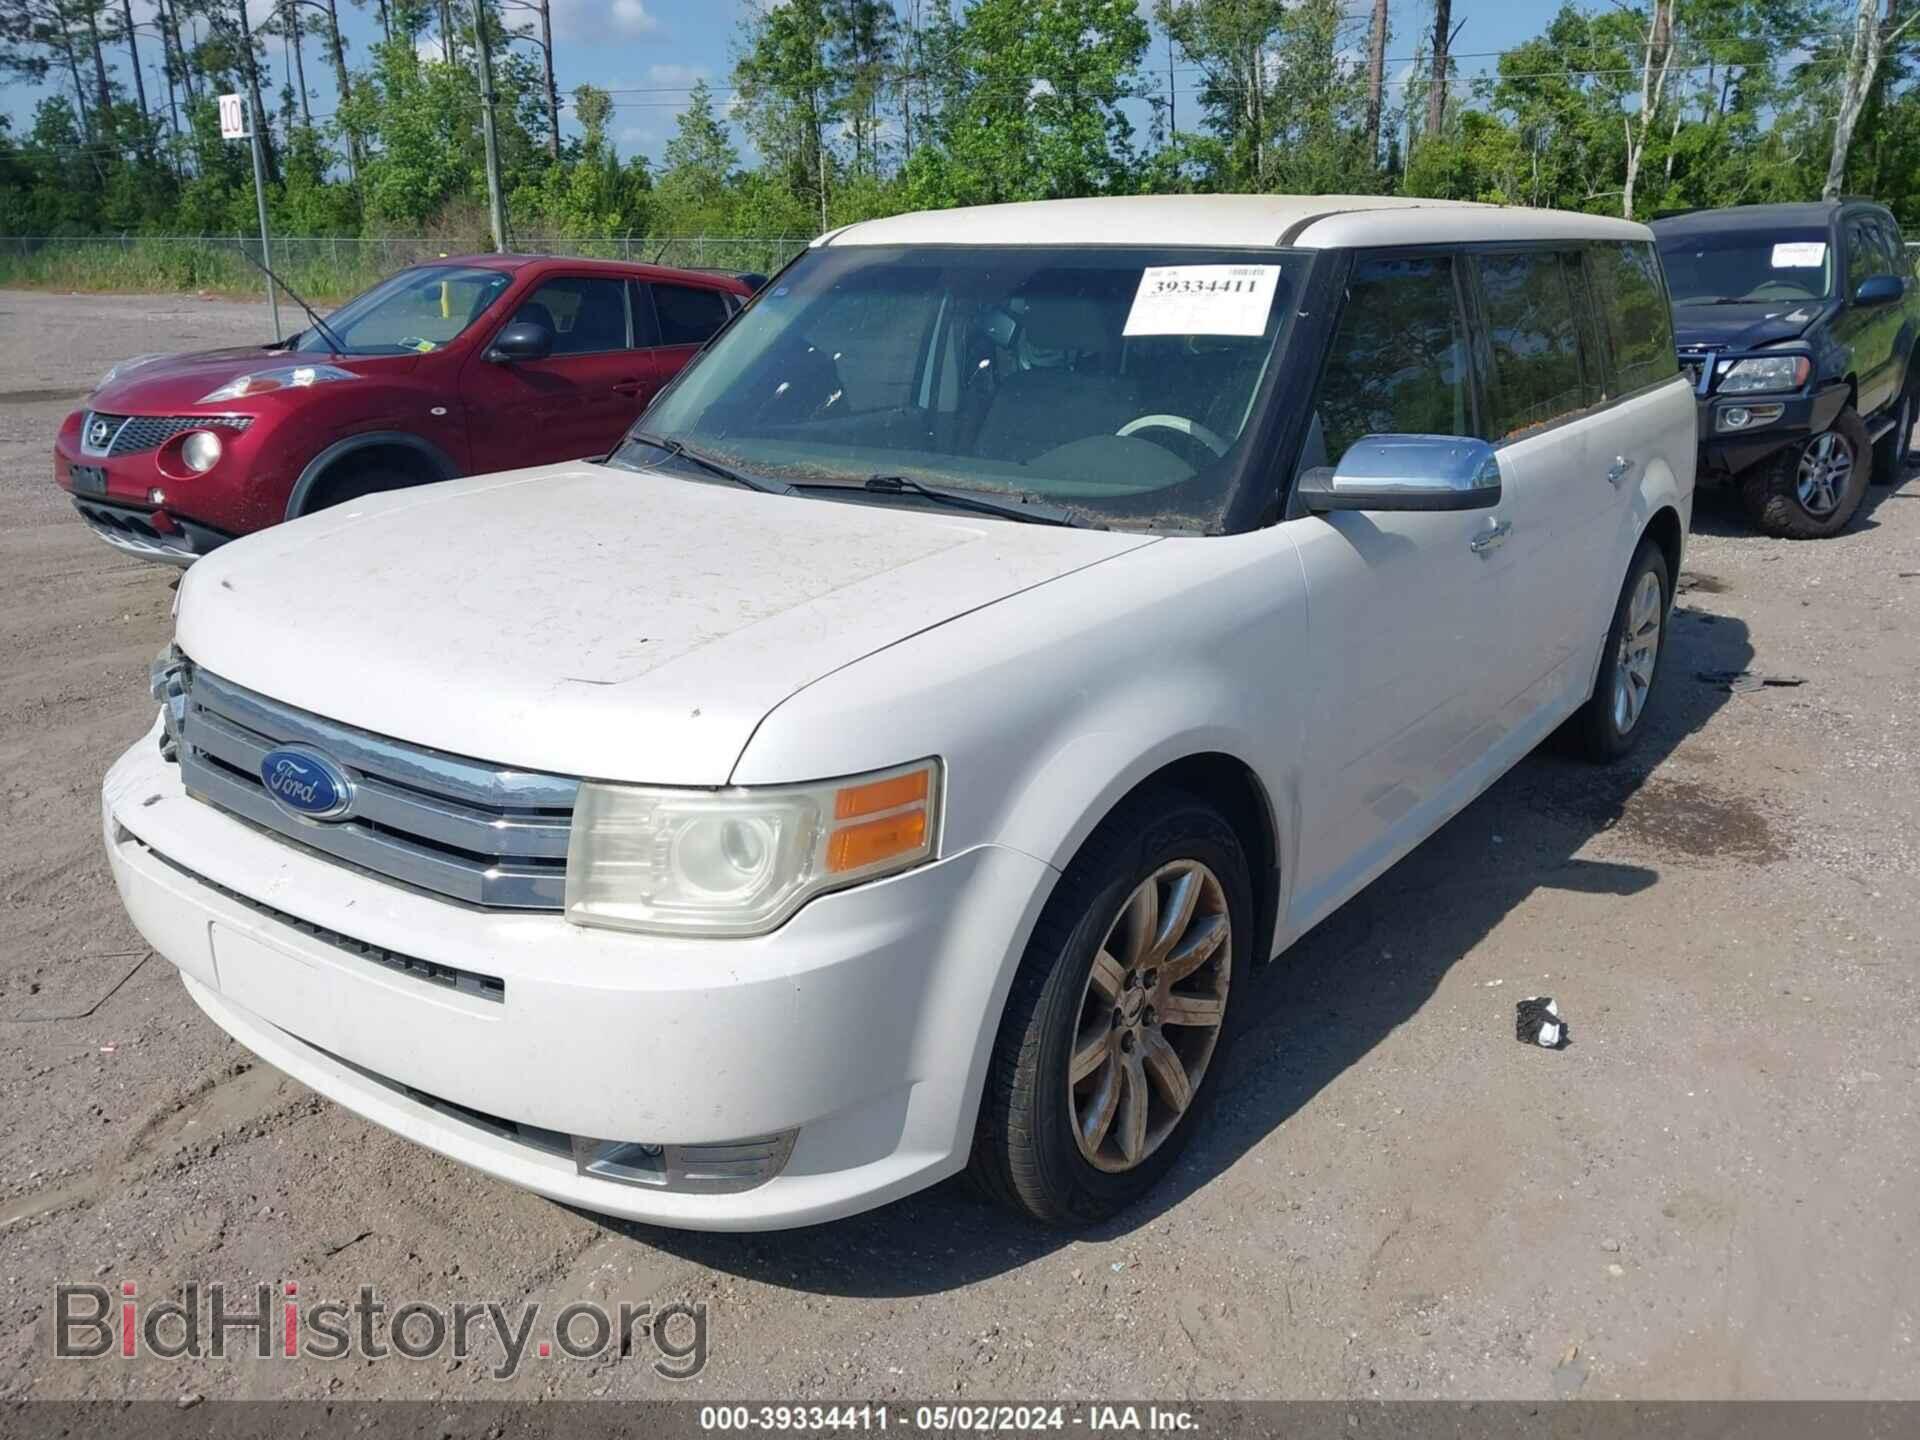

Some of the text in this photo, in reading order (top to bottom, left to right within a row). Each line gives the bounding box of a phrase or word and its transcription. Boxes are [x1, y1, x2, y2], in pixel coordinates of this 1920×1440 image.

[222, 100, 240, 132] 10
[1151, 279, 1257, 294] 39334411
[270, 759, 319, 803] Ford
